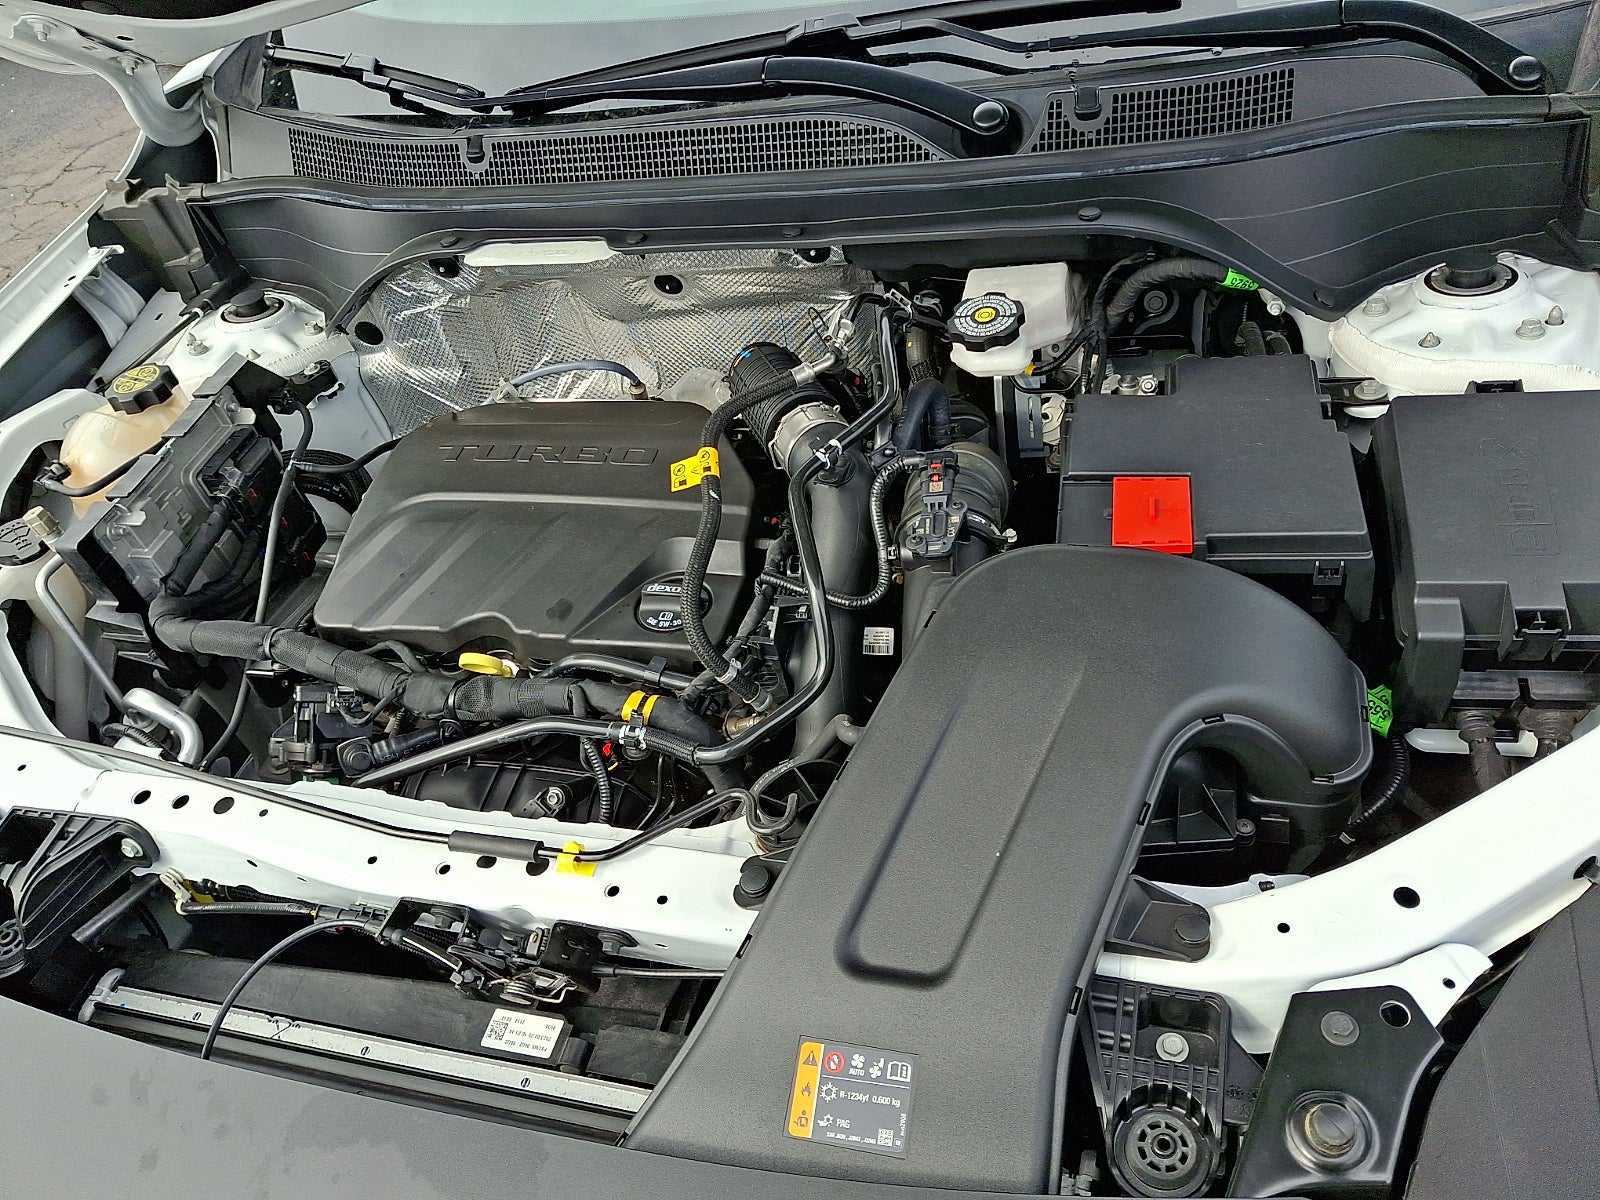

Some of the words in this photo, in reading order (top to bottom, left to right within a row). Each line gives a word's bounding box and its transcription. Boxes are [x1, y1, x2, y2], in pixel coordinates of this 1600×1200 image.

[439, 444, 659, 466] TURBO
[646, 583, 682, 593] dexo
[848, 1068, 865, 1076] AUTO
[839, 1090, 869, 1103] R-1234yf
[871, 1096, 891, 1105] 0.600
[891, 1097, 901, 1108] kg
[836, 1119, 851, 1129] PAG
